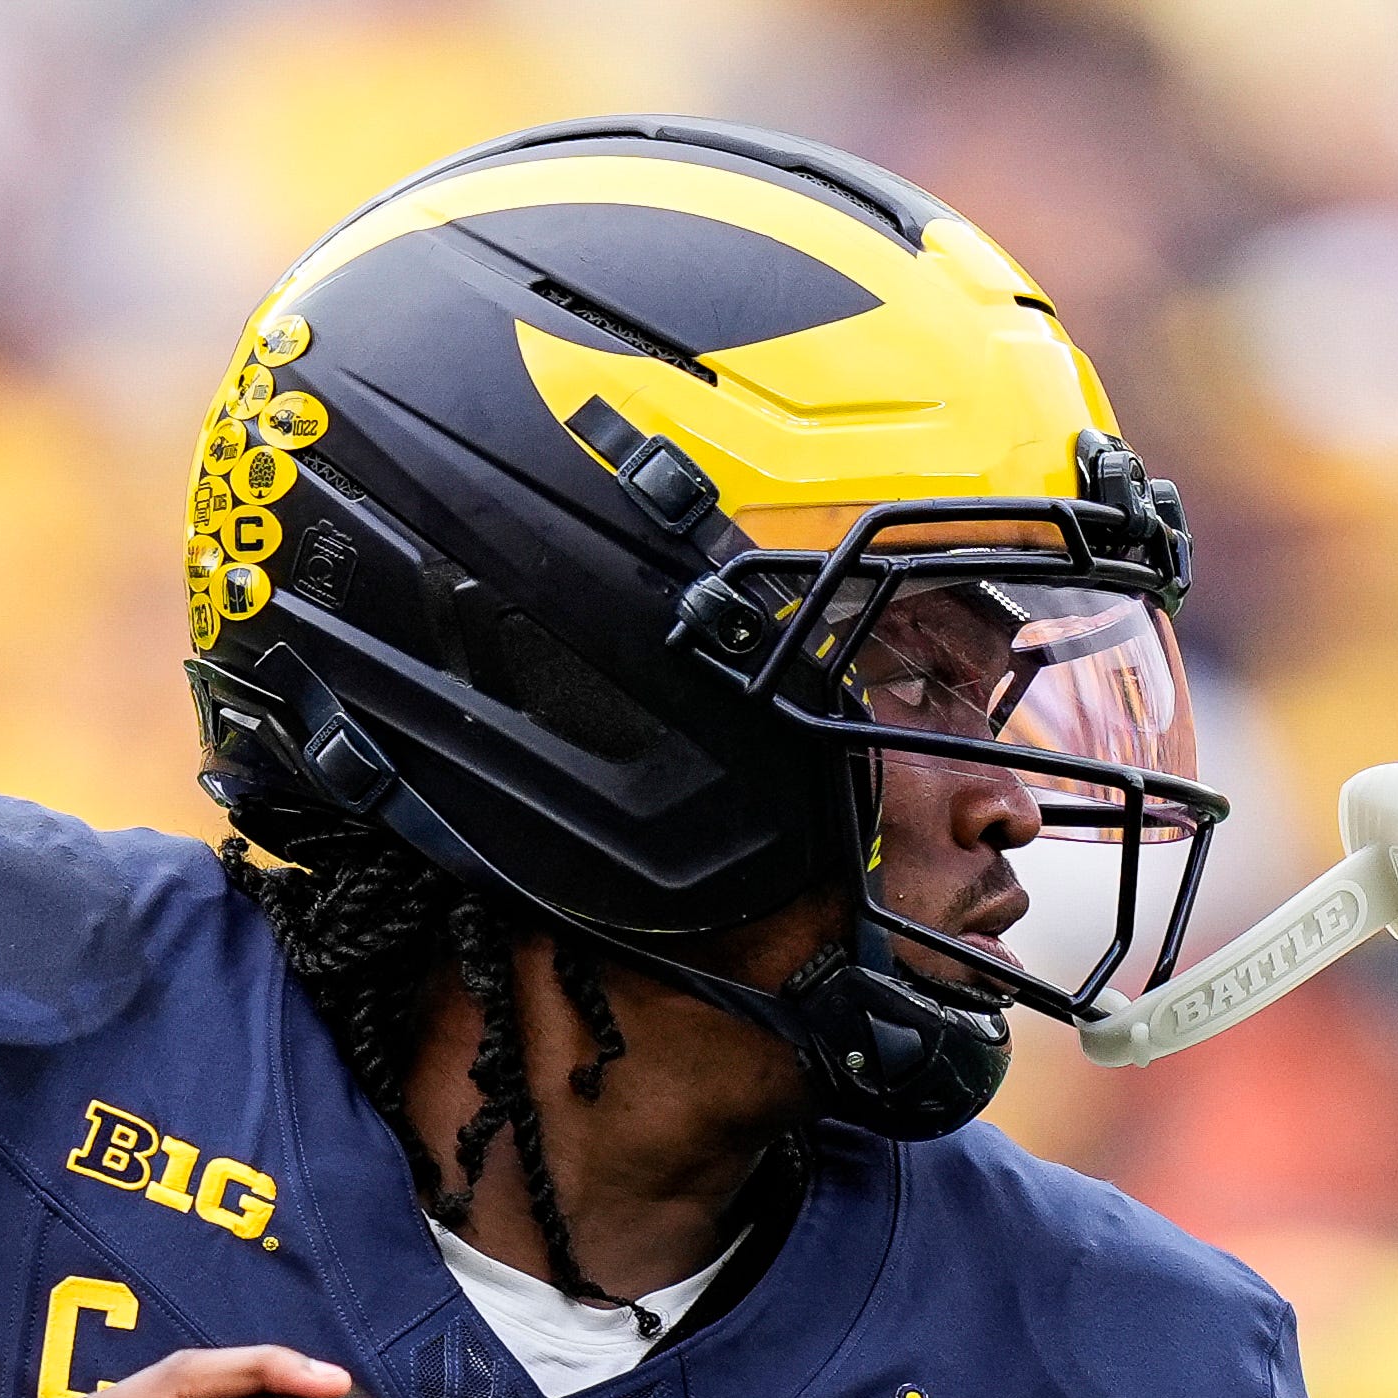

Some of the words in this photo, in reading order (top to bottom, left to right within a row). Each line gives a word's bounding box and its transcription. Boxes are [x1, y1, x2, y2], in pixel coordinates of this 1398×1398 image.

[292, 418, 318, 436] 1022
[234, 516, 264, 552] C
[1170, 895, 1350, 1035] BATTLE
